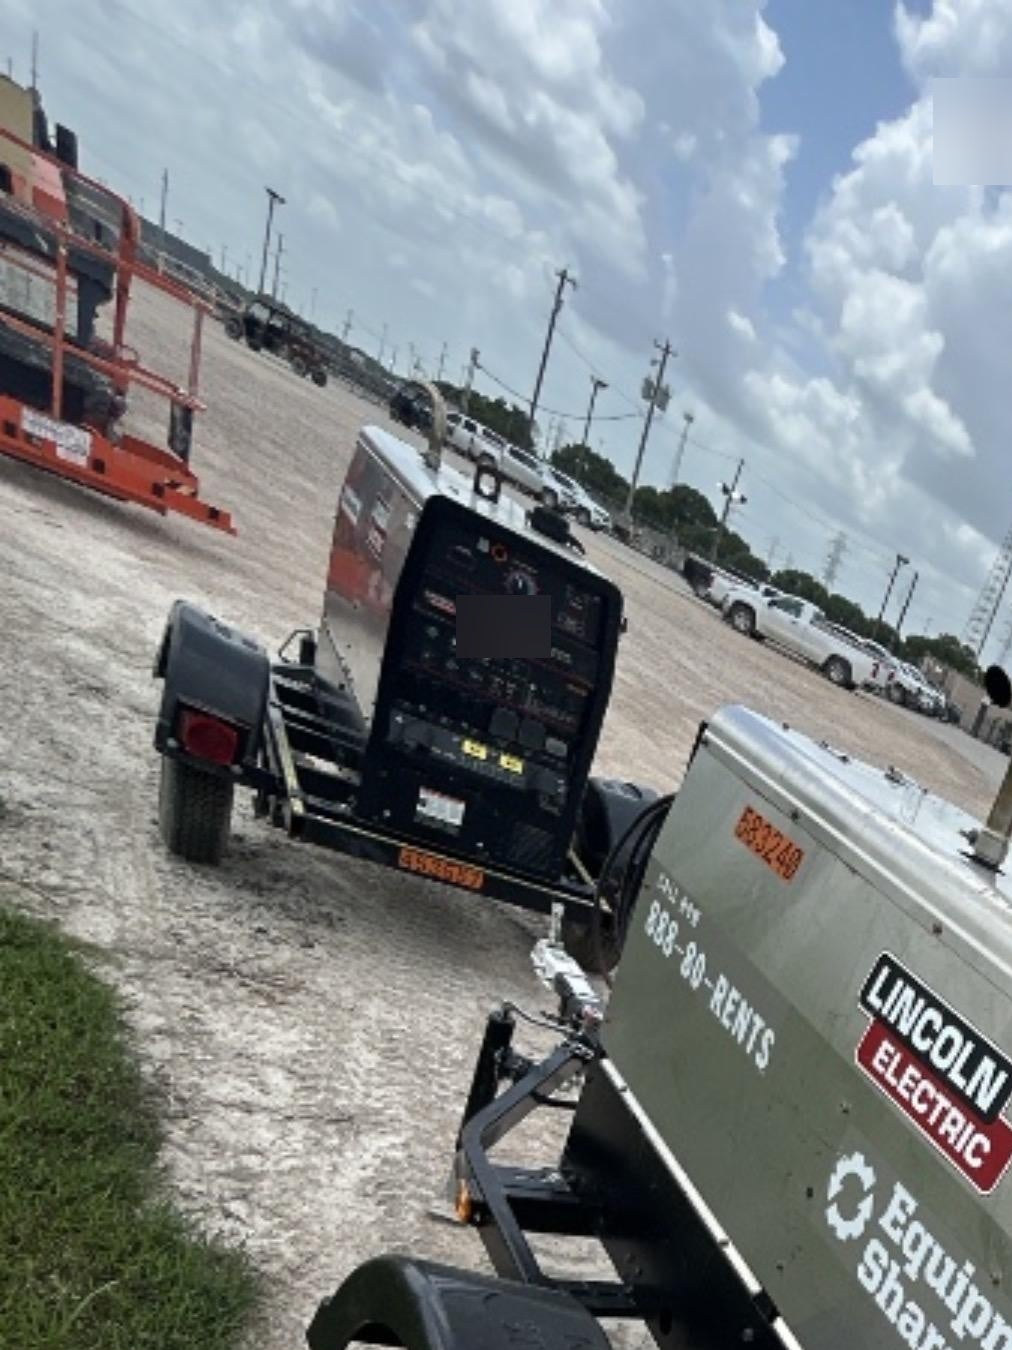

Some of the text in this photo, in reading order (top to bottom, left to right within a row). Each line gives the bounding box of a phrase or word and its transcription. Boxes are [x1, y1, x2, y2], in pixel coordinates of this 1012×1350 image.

[644, 899, 776, 1070] 888-80-RENTS
[866, 964, 1008, 1113] LINCOLN
[871, 1039, 991, 1169] ELECTRIC
